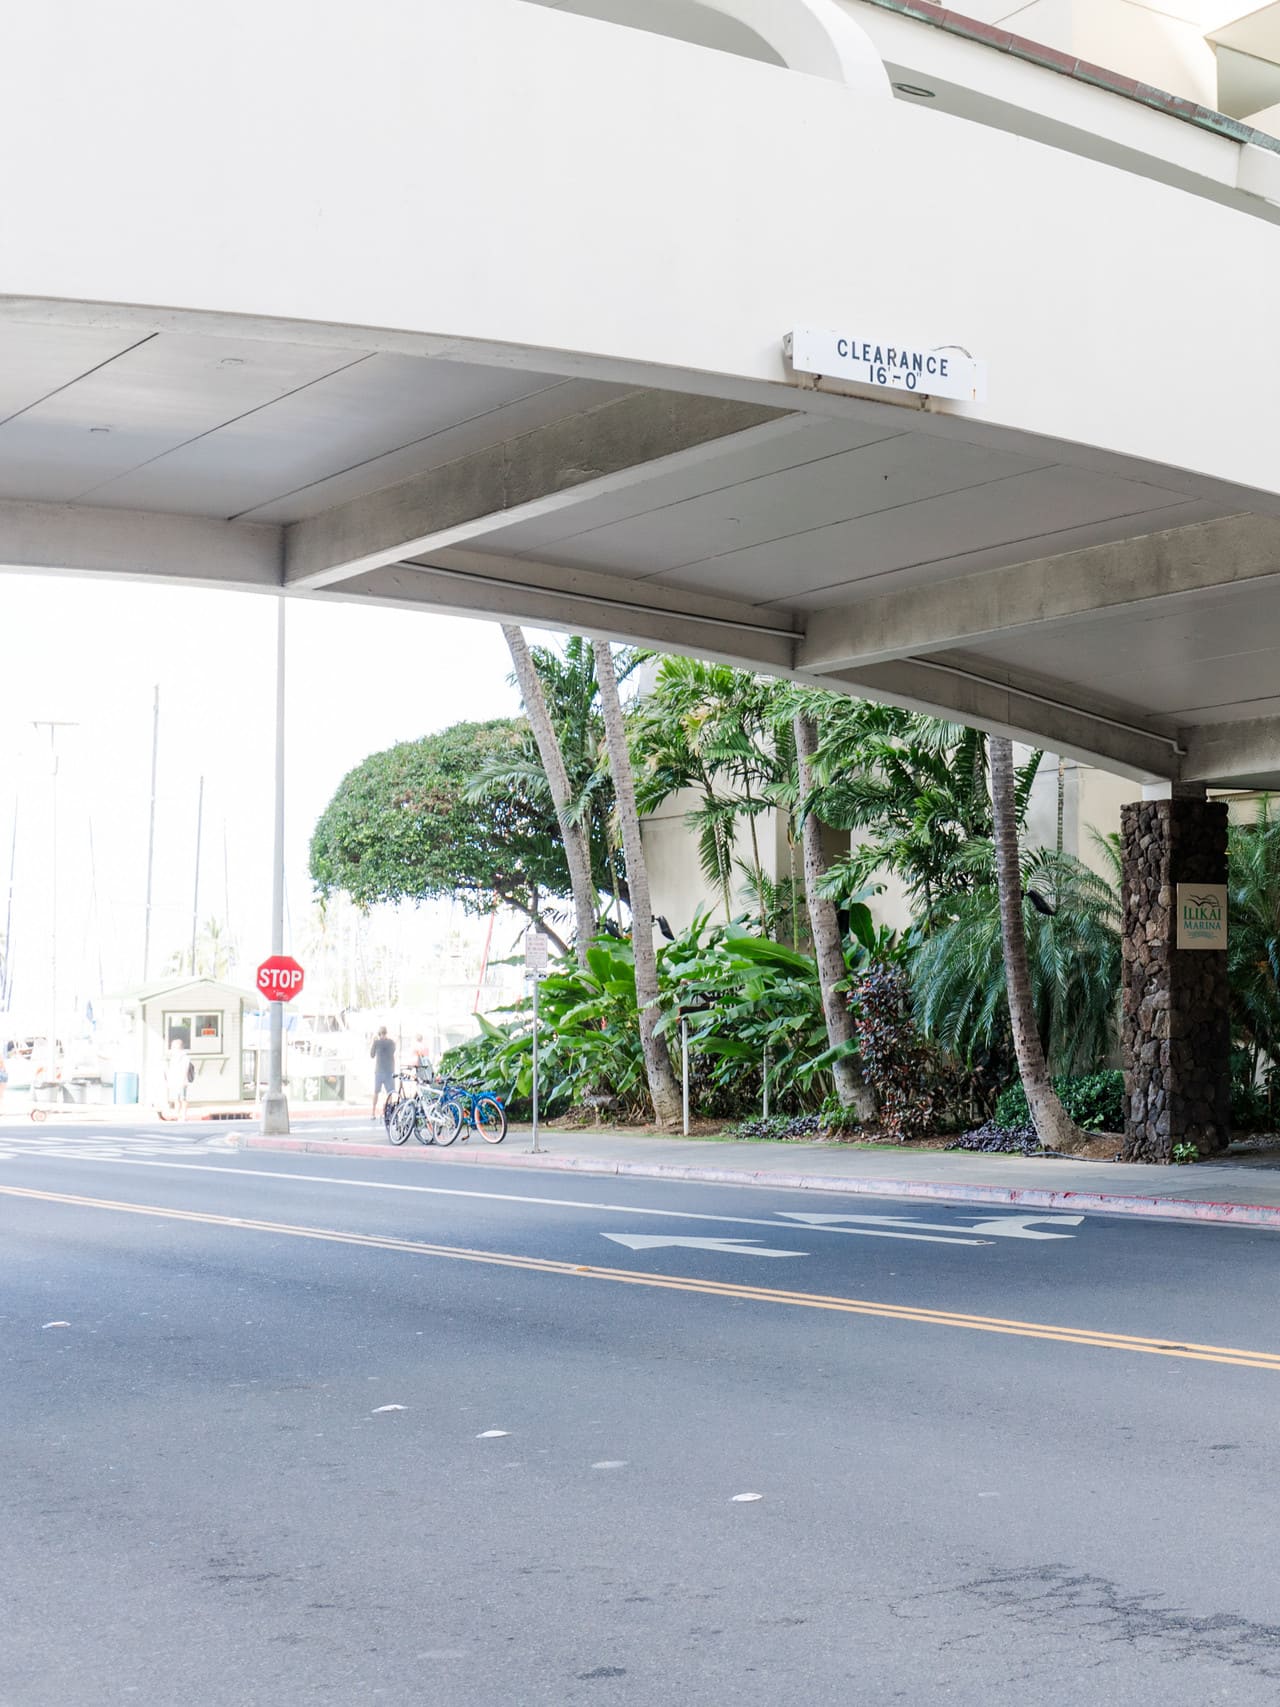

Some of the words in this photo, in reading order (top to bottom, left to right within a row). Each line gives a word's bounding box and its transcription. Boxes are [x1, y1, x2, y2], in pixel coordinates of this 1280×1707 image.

[837, 339, 949, 377] CLEARANCE
[1183, 905, 1221, 920] ILIKAI
[1184, 921, 1221, 929] MARINA
[259, 968, 303, 989] STOP
